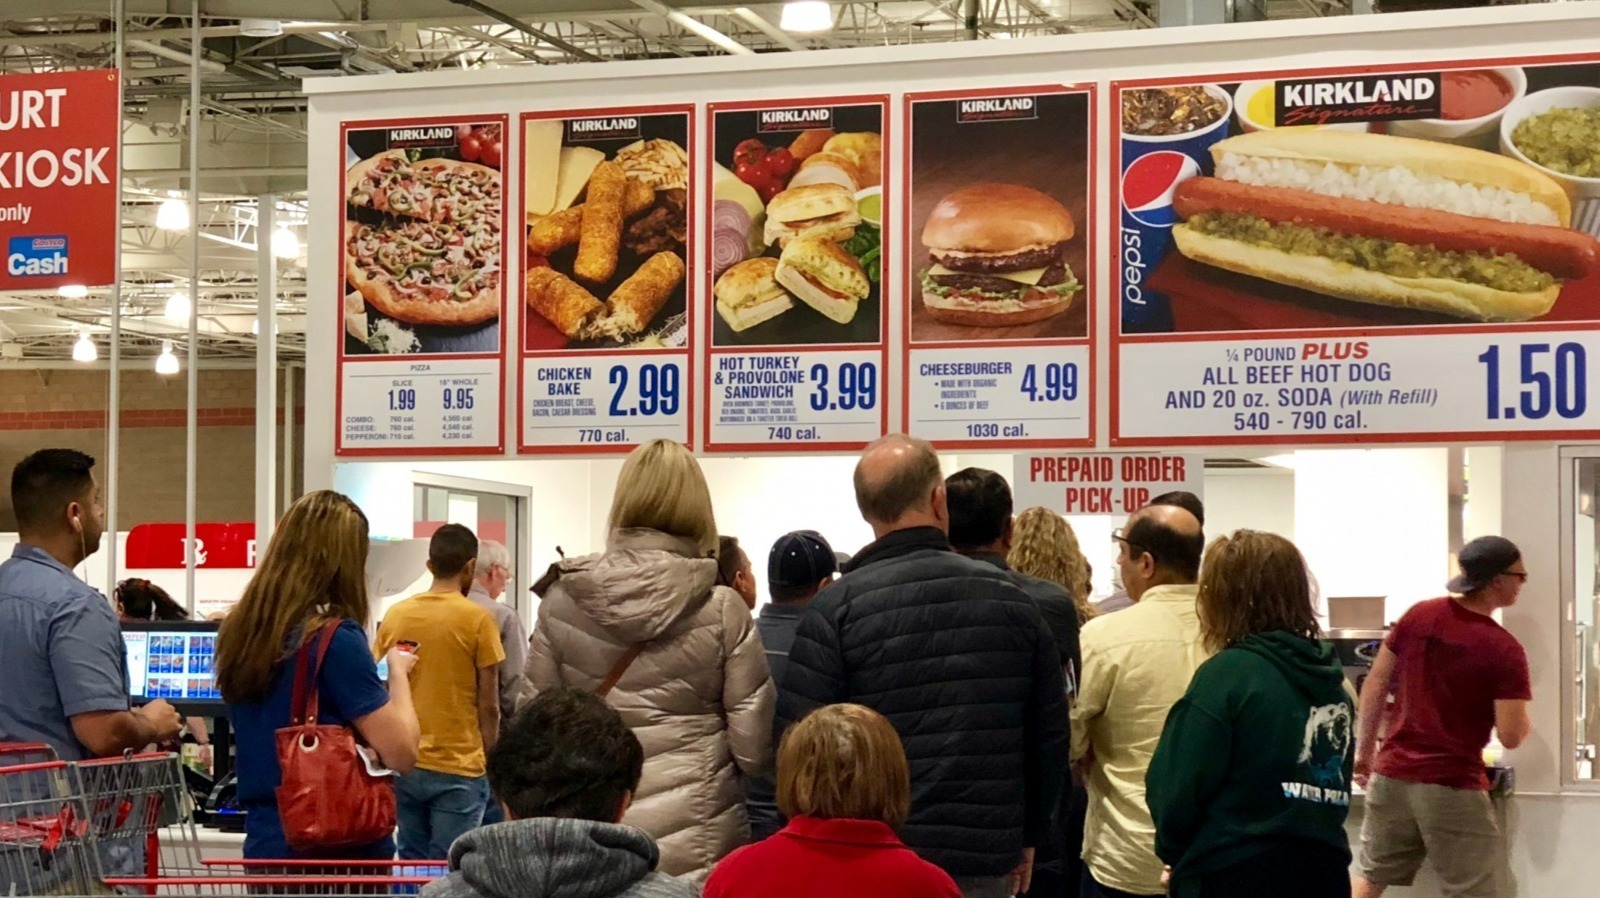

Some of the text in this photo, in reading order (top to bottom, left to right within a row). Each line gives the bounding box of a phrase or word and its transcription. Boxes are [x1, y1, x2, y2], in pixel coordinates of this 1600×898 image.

[1284, 77, 1435, 107] KIRKLAND
[961, 98, 1033, 113] KIRKLAND
[1284, 103, 1435, 125] Signature
[572, 118, 637, 132] KIRKLAND
[761, 109, 830, 123] KIRKLAND
[391, 127, 453, 141] KIRKLAND
[0, 203, 32, 224] only
[8, 252, 68, 275] Cash
[1121, 227, 1147, 305] pepsi
[1244, 347, 1296, 361] POUND
[1301, 341, 1369, 360] PLUS
[719, 356, 800, 370] HOT TURKEY
[919, 362, 1013, 376] CHEESEBURGER
[392, 379, 413, 387] SLICE
[452, 378, 479, 386] WHOLE
[537, 367, 592, 381] CHICKEN
[714, 370, 805, 385] & PROVOLONE
[1020, 362, 1078, 402] 4.99
[1203, 362, 1391, 385] ALL BEEF HOT DOG
[1478, 341, 1587, 420] 1.50
[548, 382, 581, 396] BAKE
[609, 363, 679, 416] 2.99
[725, 385, 794, 399] SANDWICH
[810, 362, 876, 411] 3.99
[388, 388, 474, 410] 1.99 9.95
[1165, 387, 1438, 409] AND 20 oz. SODA (With Refill)
[966, 423, 1029, 437] 1030 cal.
[1234, 412, 1270, 431] 540
[1291, 411, 1326, 429] 790
[1334, 410, 1368, 428] cal.
[579, 429, 630, 442] 770 cal.
[768, 426, 821, 440] 740 cal.
[1030, 456, 1186, 482] PREPAID ORDER
[1066, 487, 1150, 513] PICK-UP
